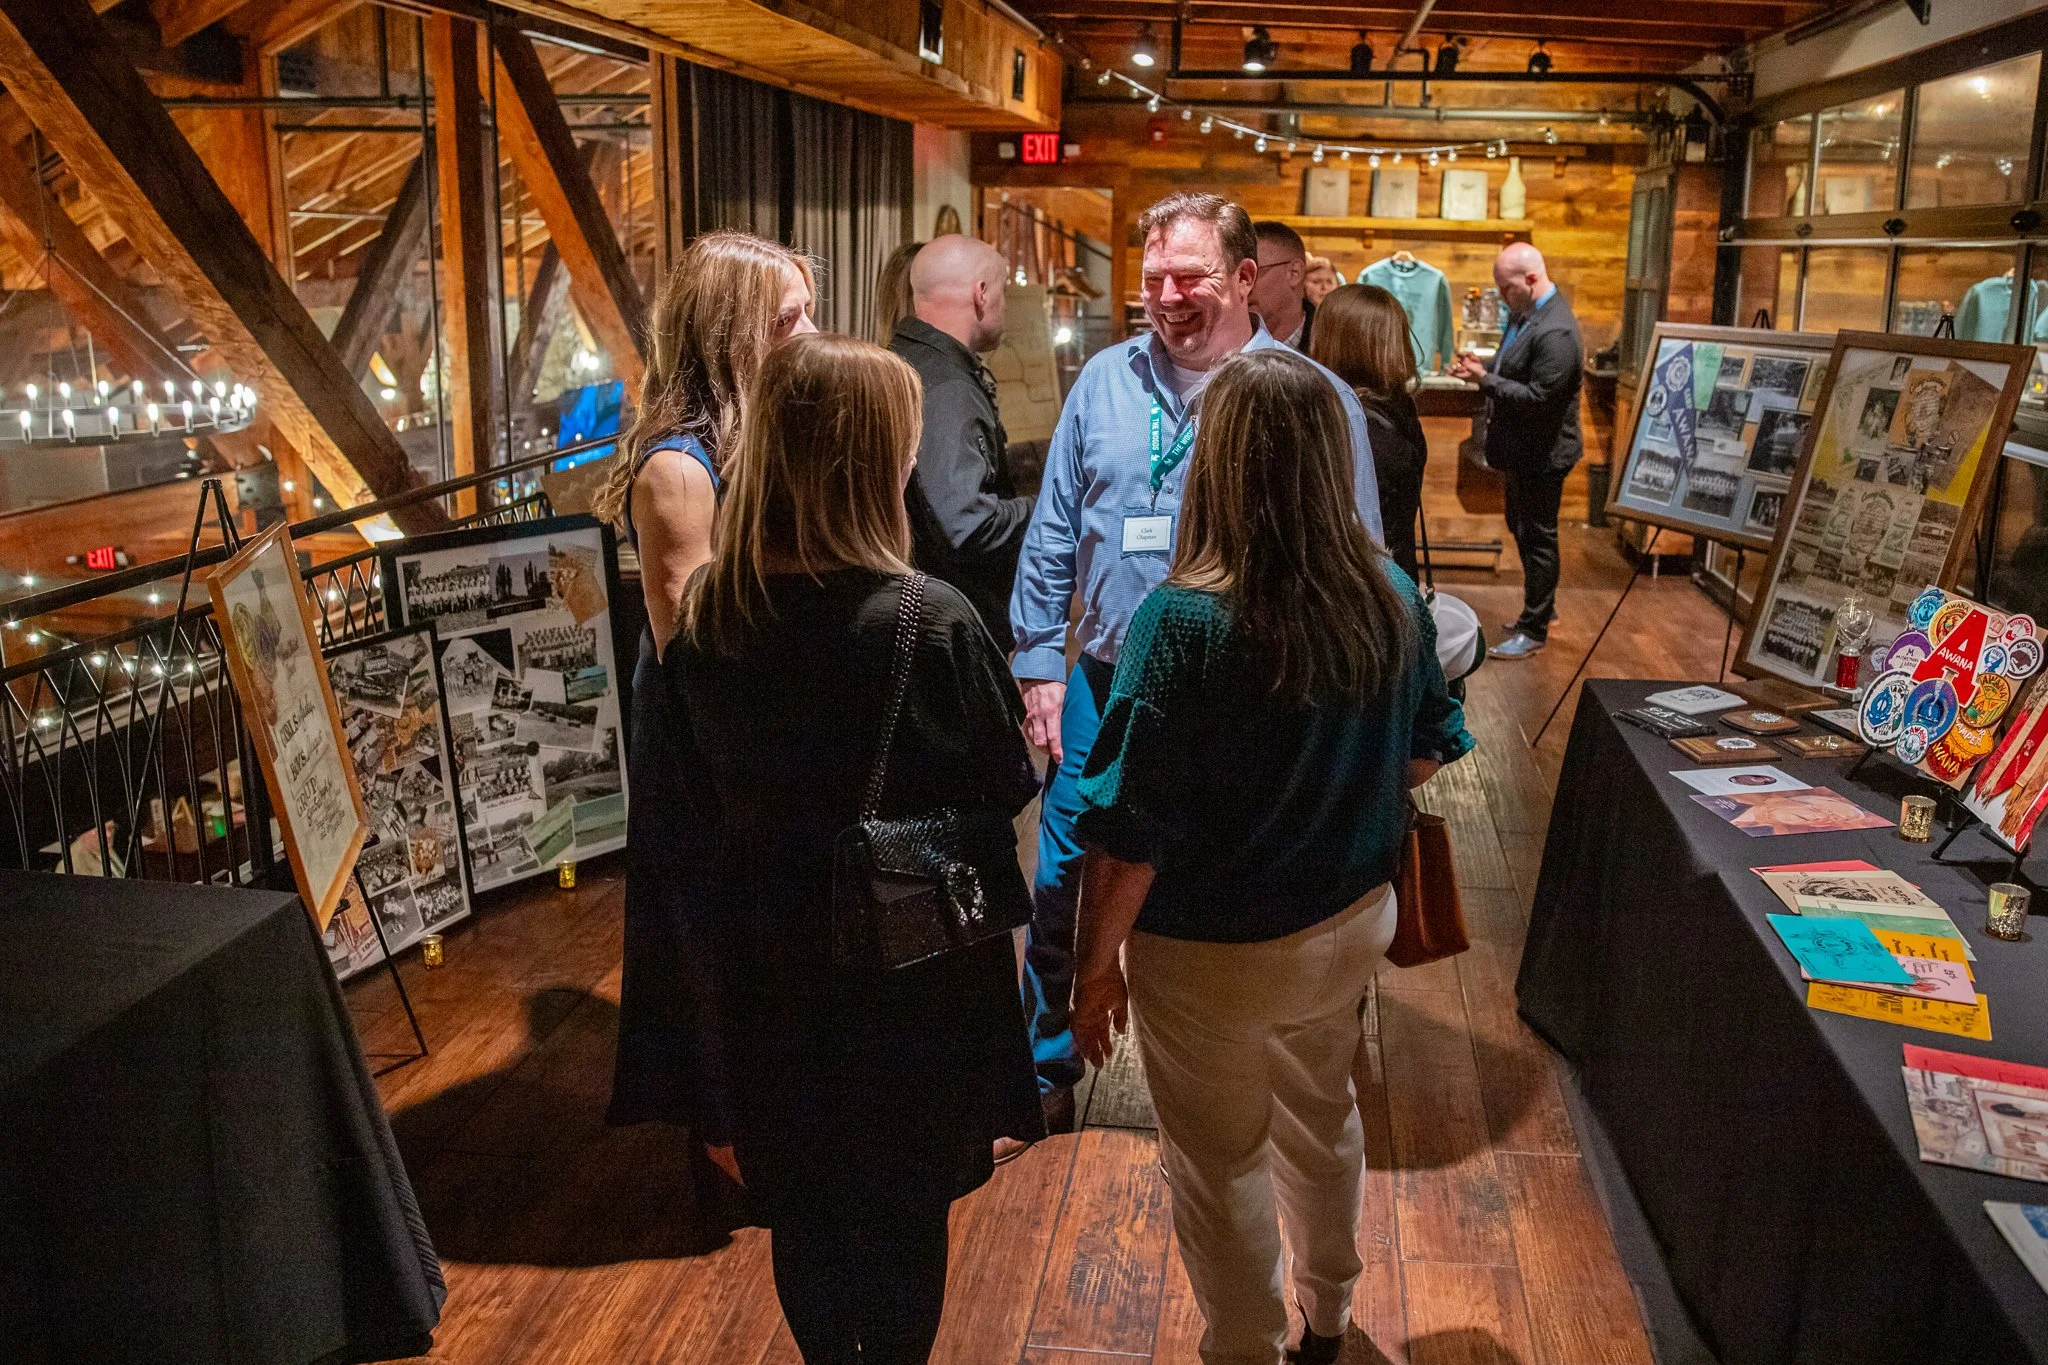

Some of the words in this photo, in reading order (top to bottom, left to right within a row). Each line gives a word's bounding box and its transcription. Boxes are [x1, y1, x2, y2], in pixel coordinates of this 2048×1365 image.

[1024, 134, 1059, 162] EXIT
[1151, 418, 1160, 429] THE
[1151, 430, 1160, 451] WOODS
[1172, 442, 1184, 456] THE
[87, 546, 115, 569] EXIT
[1945, 603, 1970, 612] AWANA
[1937, 646, 1974, 672] AWANA
[1982, 674, 2008, 698] AWANA
[1909, 726, 1927, 746] AWANA
[1932, 741, 1961, 774] WANA
